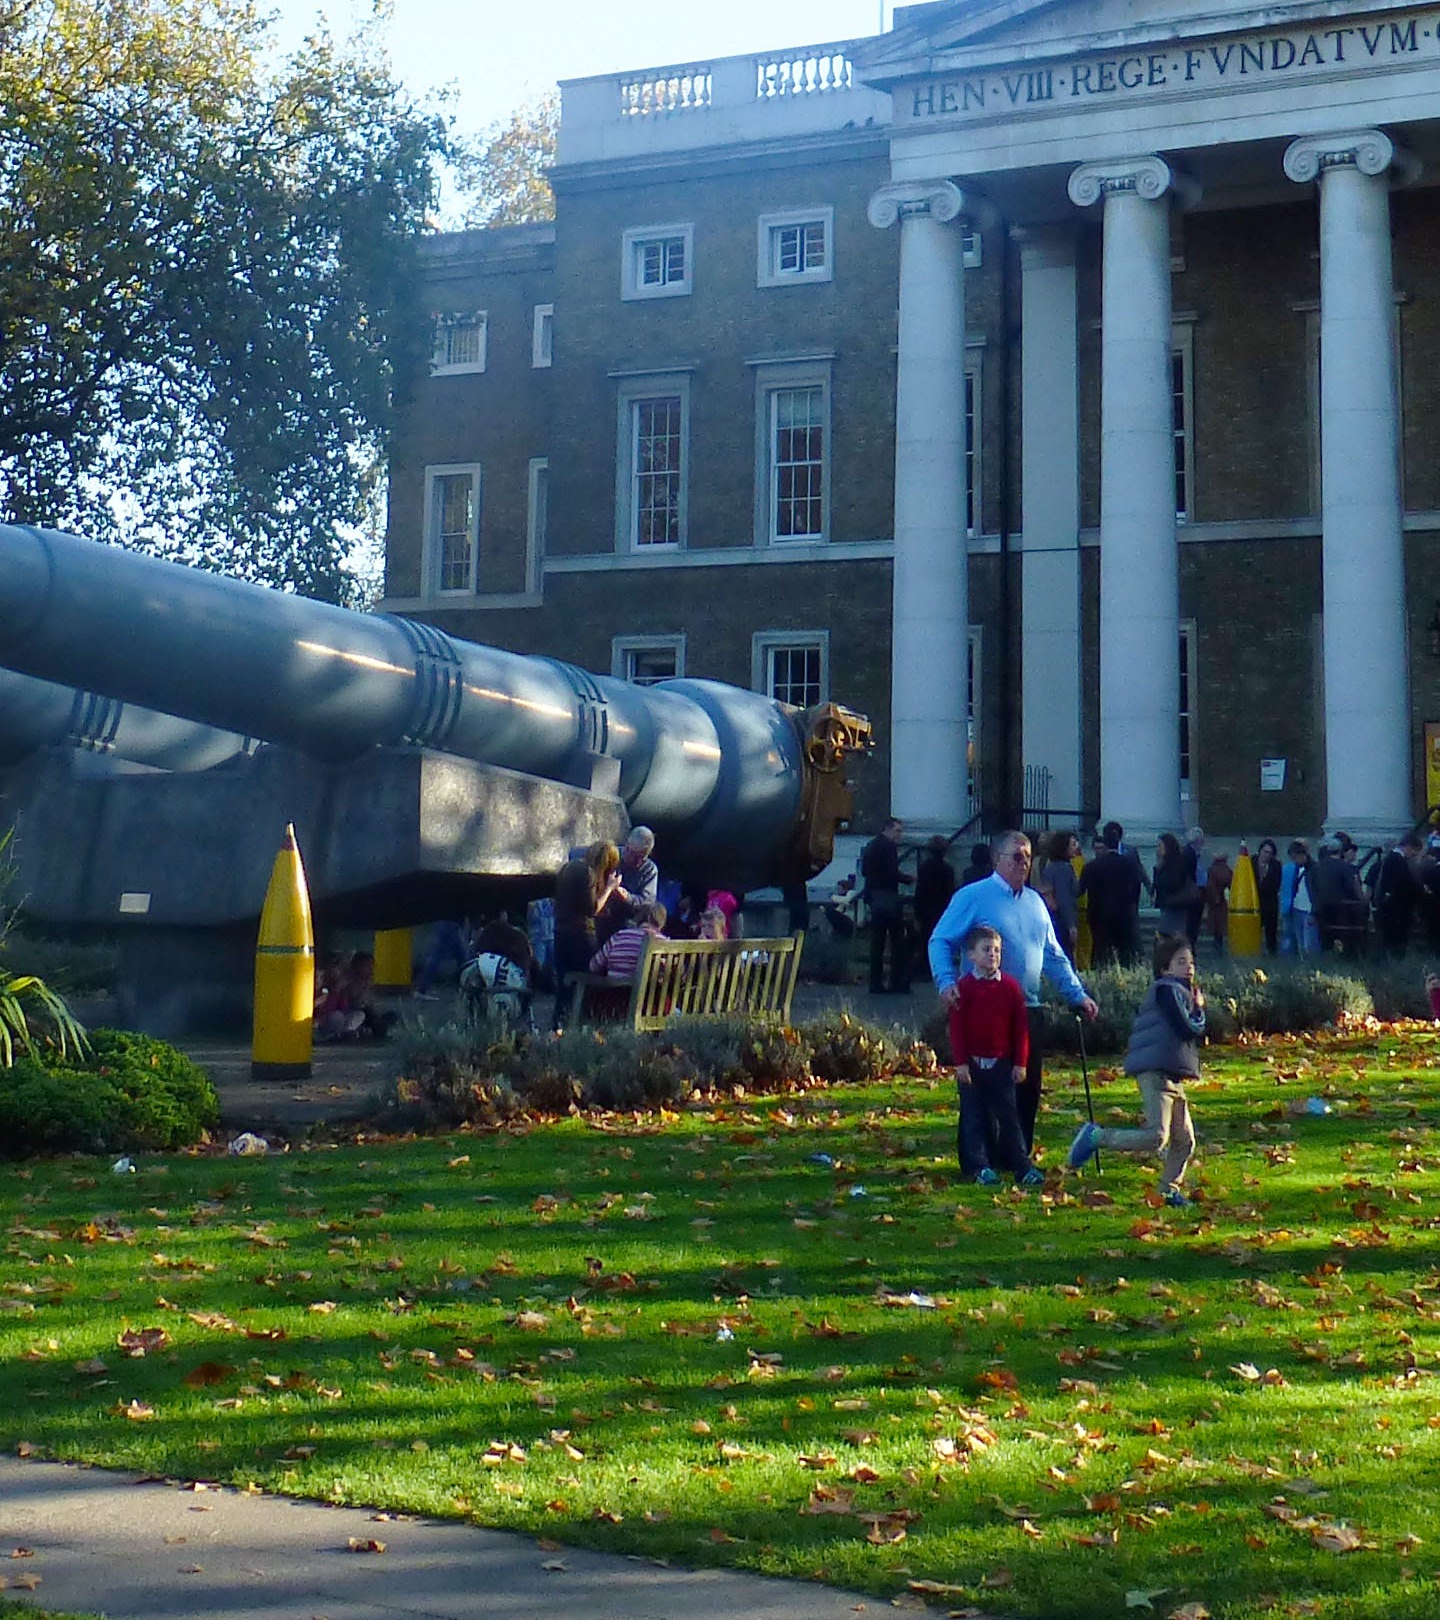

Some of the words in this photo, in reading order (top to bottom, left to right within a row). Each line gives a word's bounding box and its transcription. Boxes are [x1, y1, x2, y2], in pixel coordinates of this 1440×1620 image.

[912, 79, 986, 117] HEN
[1001, 68, 1055, 104] VIII
[1070, 54, 1167, 96] REGE
[1183, 18, 1419, 81] FVNDATVM
